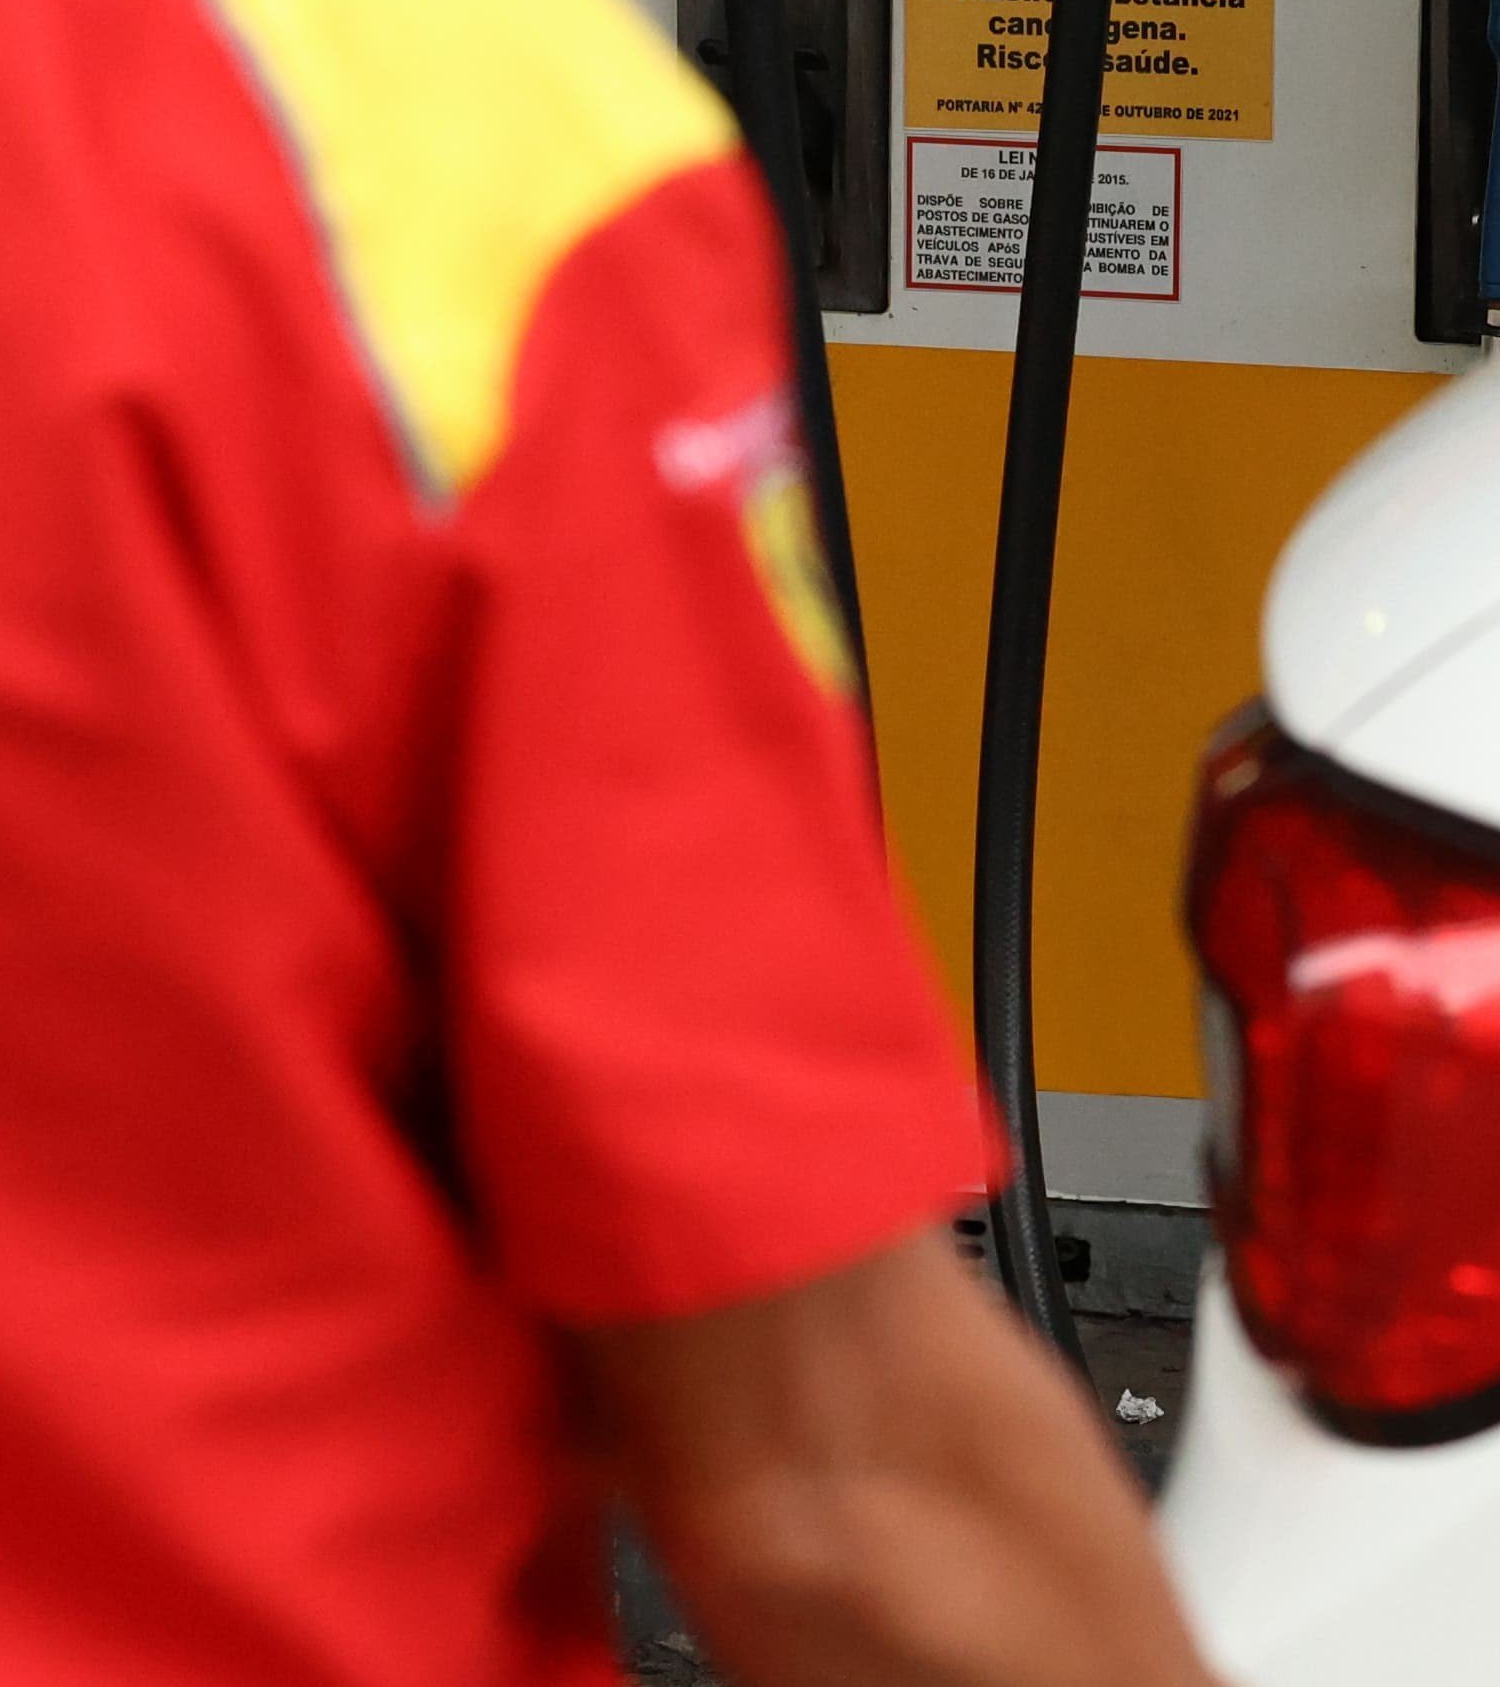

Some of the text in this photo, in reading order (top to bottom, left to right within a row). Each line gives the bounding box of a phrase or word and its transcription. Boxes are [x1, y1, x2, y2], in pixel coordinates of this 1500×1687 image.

[937, 99, 1004, 112] PORTARIA
[1115, 105, 1238, 121] OUTUBRO DE 2021
